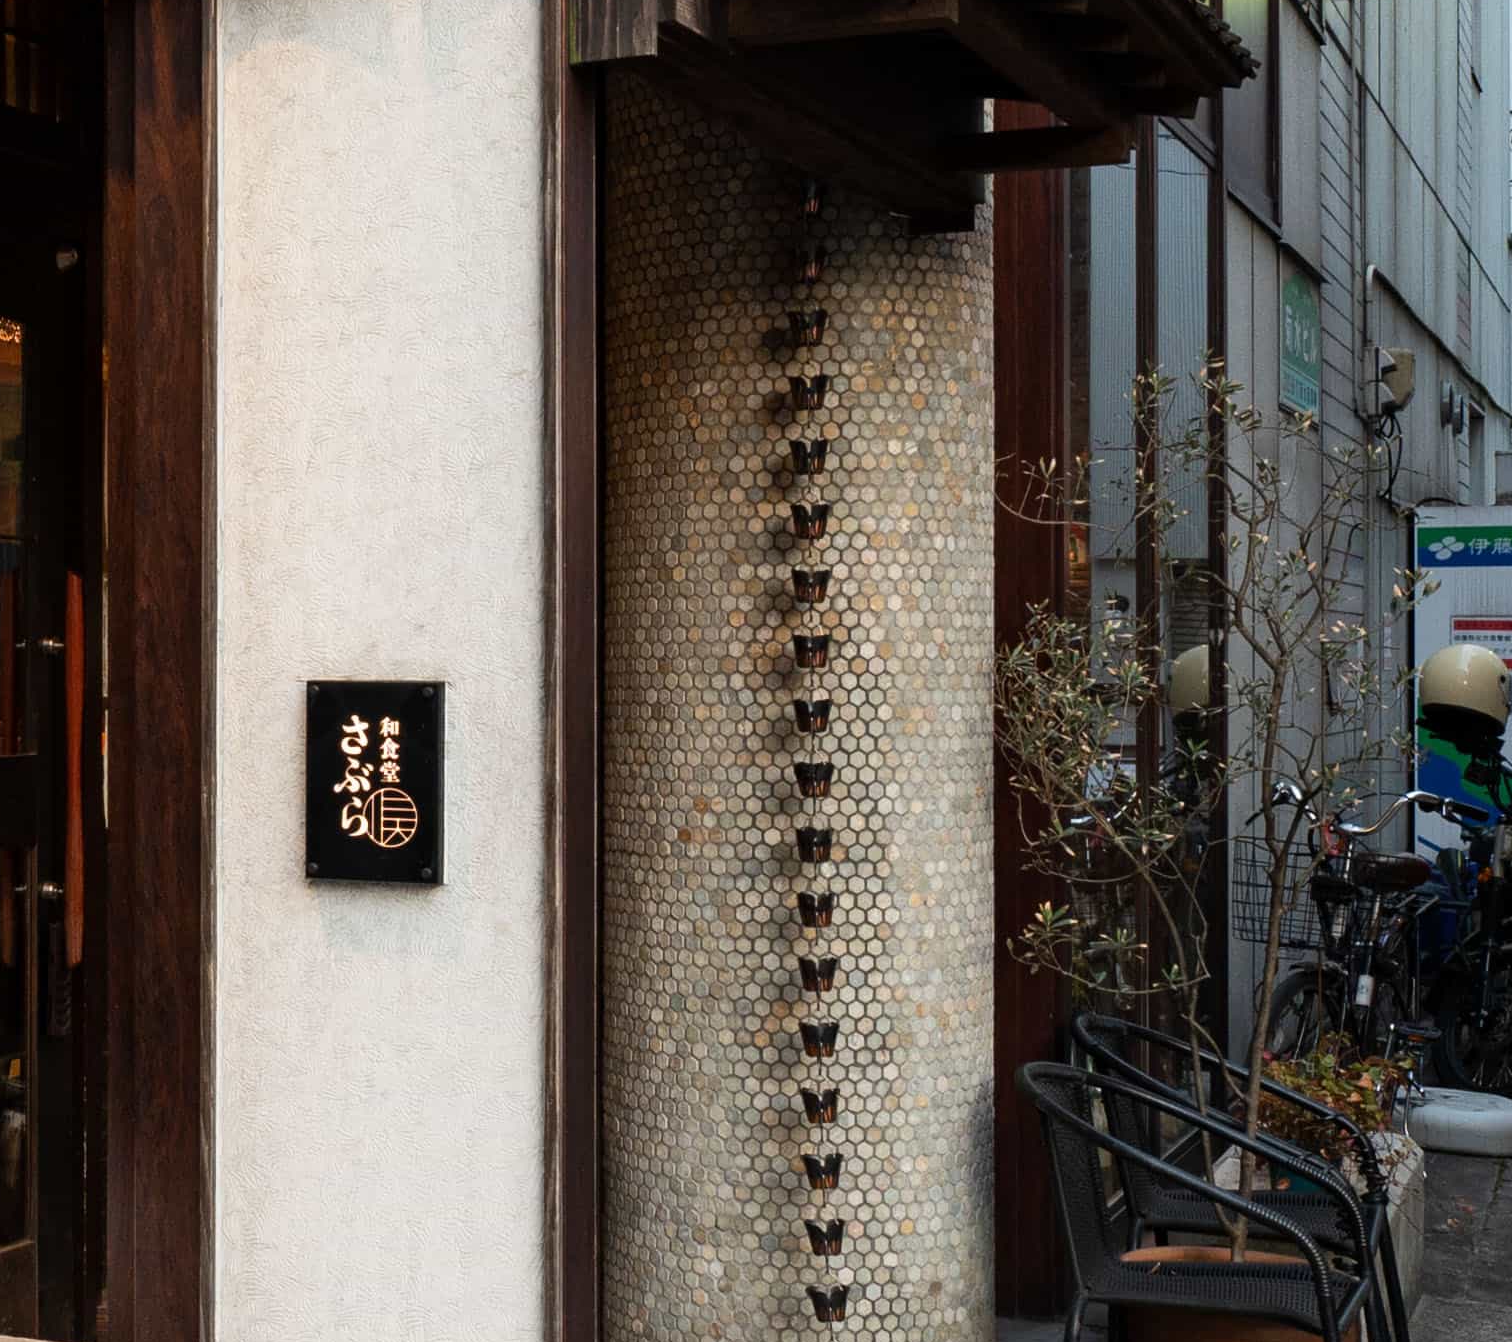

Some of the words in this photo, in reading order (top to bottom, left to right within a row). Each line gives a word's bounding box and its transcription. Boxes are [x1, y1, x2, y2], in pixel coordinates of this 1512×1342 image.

[332, 714, 374, 837] さぶら
[379, 716, 401, 784] 和食堂
